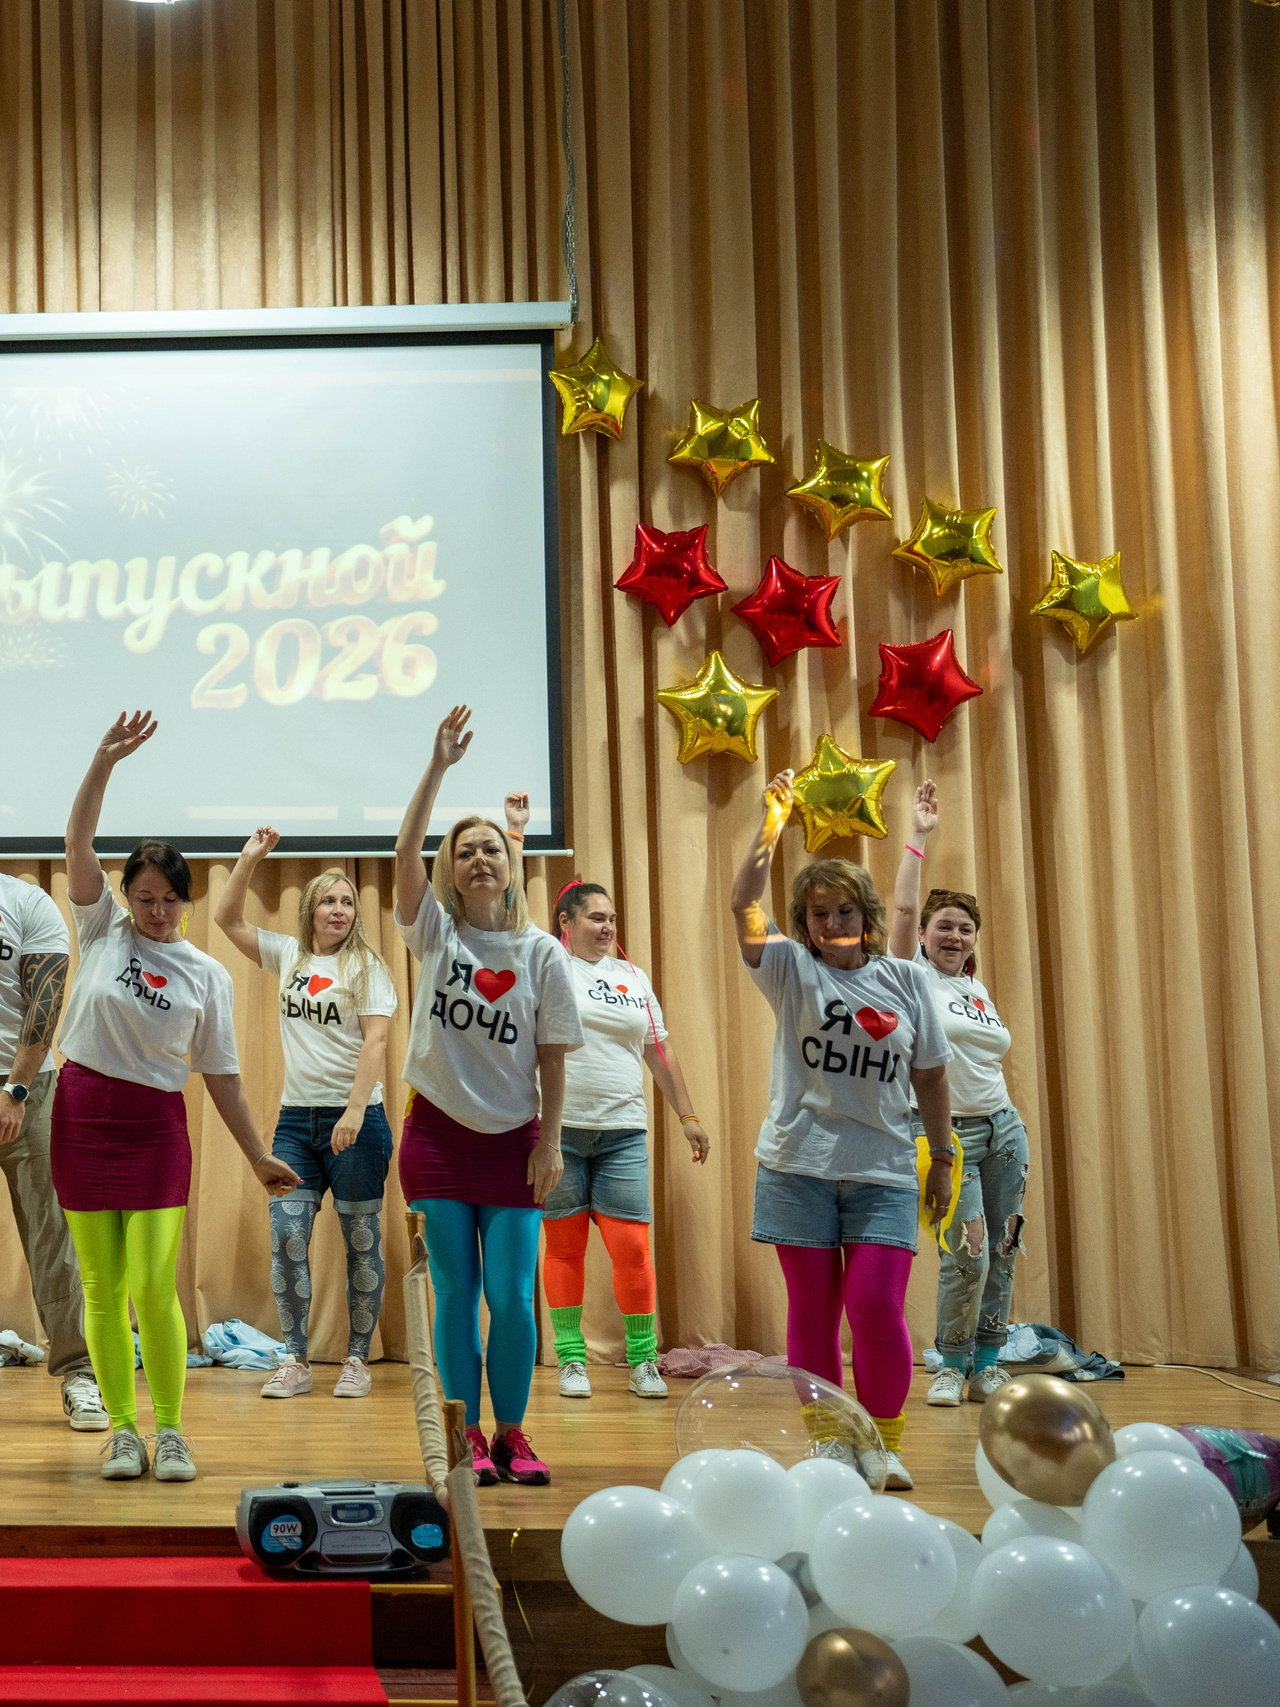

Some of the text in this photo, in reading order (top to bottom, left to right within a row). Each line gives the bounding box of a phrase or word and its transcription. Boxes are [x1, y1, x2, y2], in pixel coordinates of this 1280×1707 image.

[191, 611, 438, 710] 2026
[286, 969, 310, 991] Я
[446, 959, 473, 993] Я
[429, 989, 518, 1044] ДОЧЬ
[819, 999, 853, 1035] Я
[948, 1001, 1005, 1029] СЫН
[273, 1523, 298, 1534] 90W
